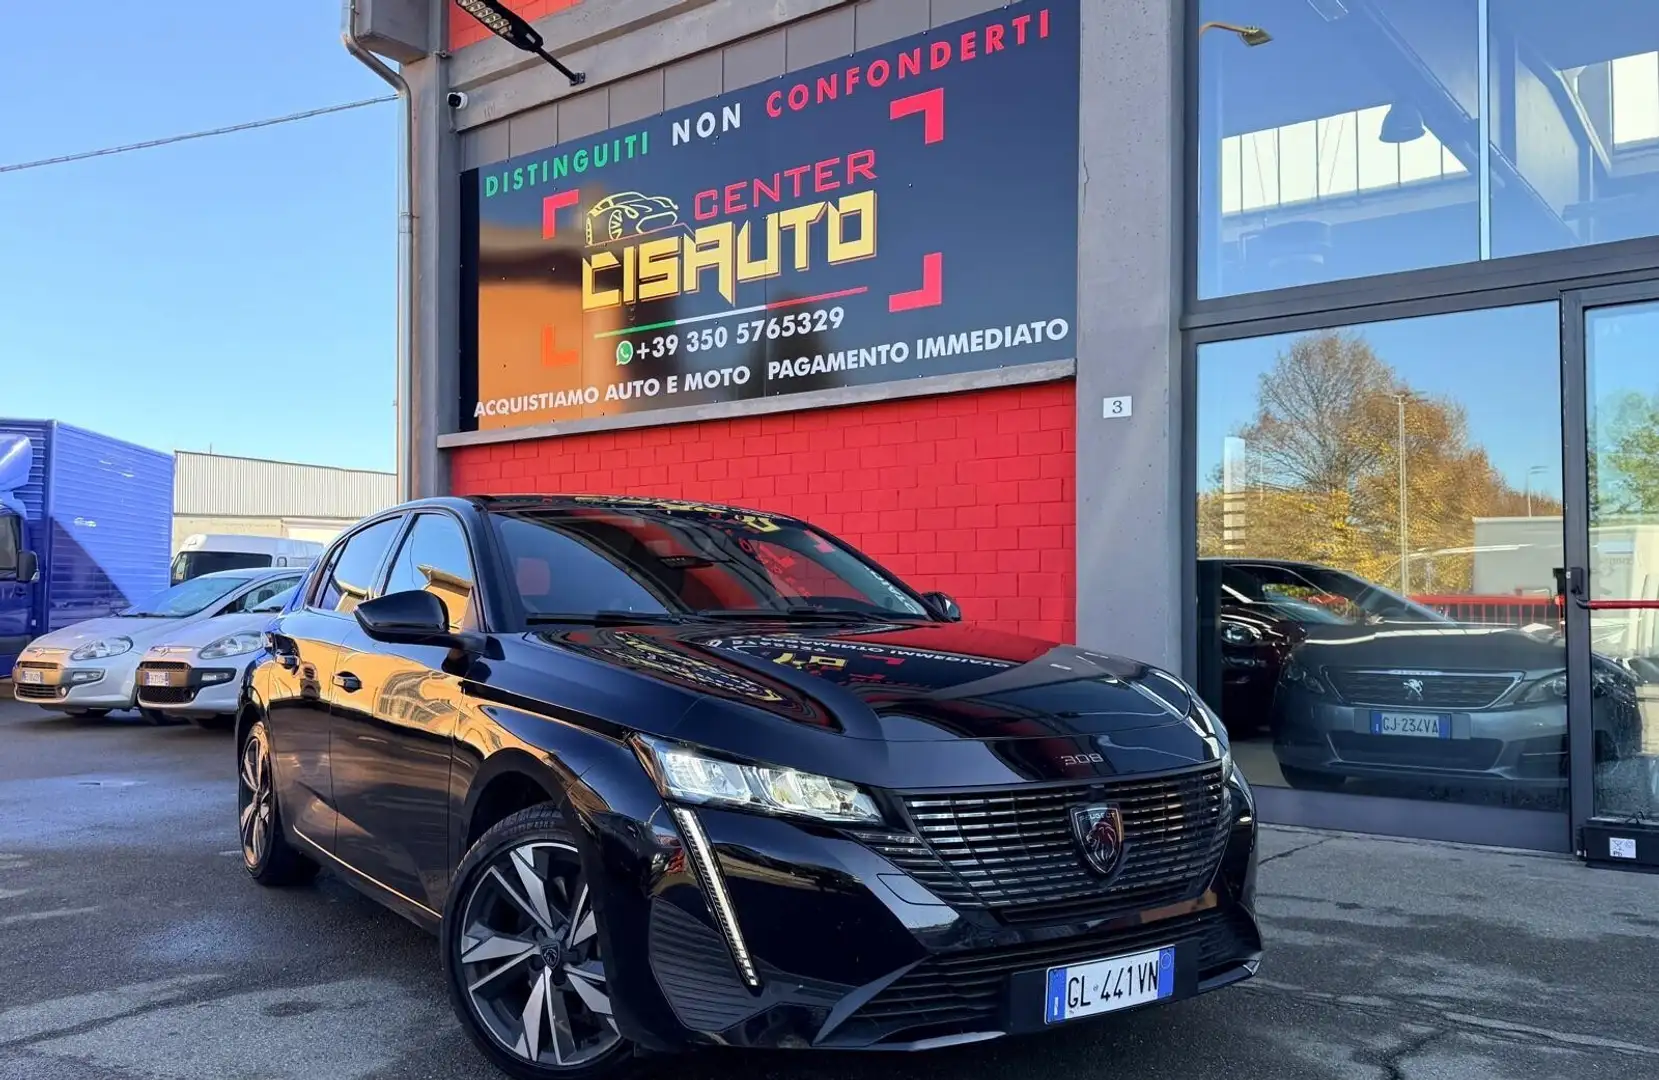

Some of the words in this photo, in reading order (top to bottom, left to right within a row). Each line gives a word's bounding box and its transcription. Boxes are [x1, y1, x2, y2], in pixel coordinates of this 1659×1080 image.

[485, 131, 648, 197] DISTINGUITI
[672, 103, 741, 146] NON
[766, 9, 1049, 117] CONFONDERTI
[694, 149, 877, 221] CENTER
[582, 190, 877, 312] CISAUTO
[636, 337, 678, 360] +39
[686, 327, 728, 353] 350
[736, 306, 844, 344] 5765329
[474, 387, 599, 417] ACQUISTIAMO
[604, 378, 660, 402] AUTO
[667, 374, 678, 394] E
[684, 365, 751, 393] MOTO
[767, 341, 909, 380] PAGAMENTO
[916, 318, 1069, 360] IMMEDIATO
[1112, 400, 1123, 414] 3
[1061, 753, 1104, 766] 308
[1068, 975, 1091, 1008] GL
[1101, 960, 1159, 1001] 441VN
